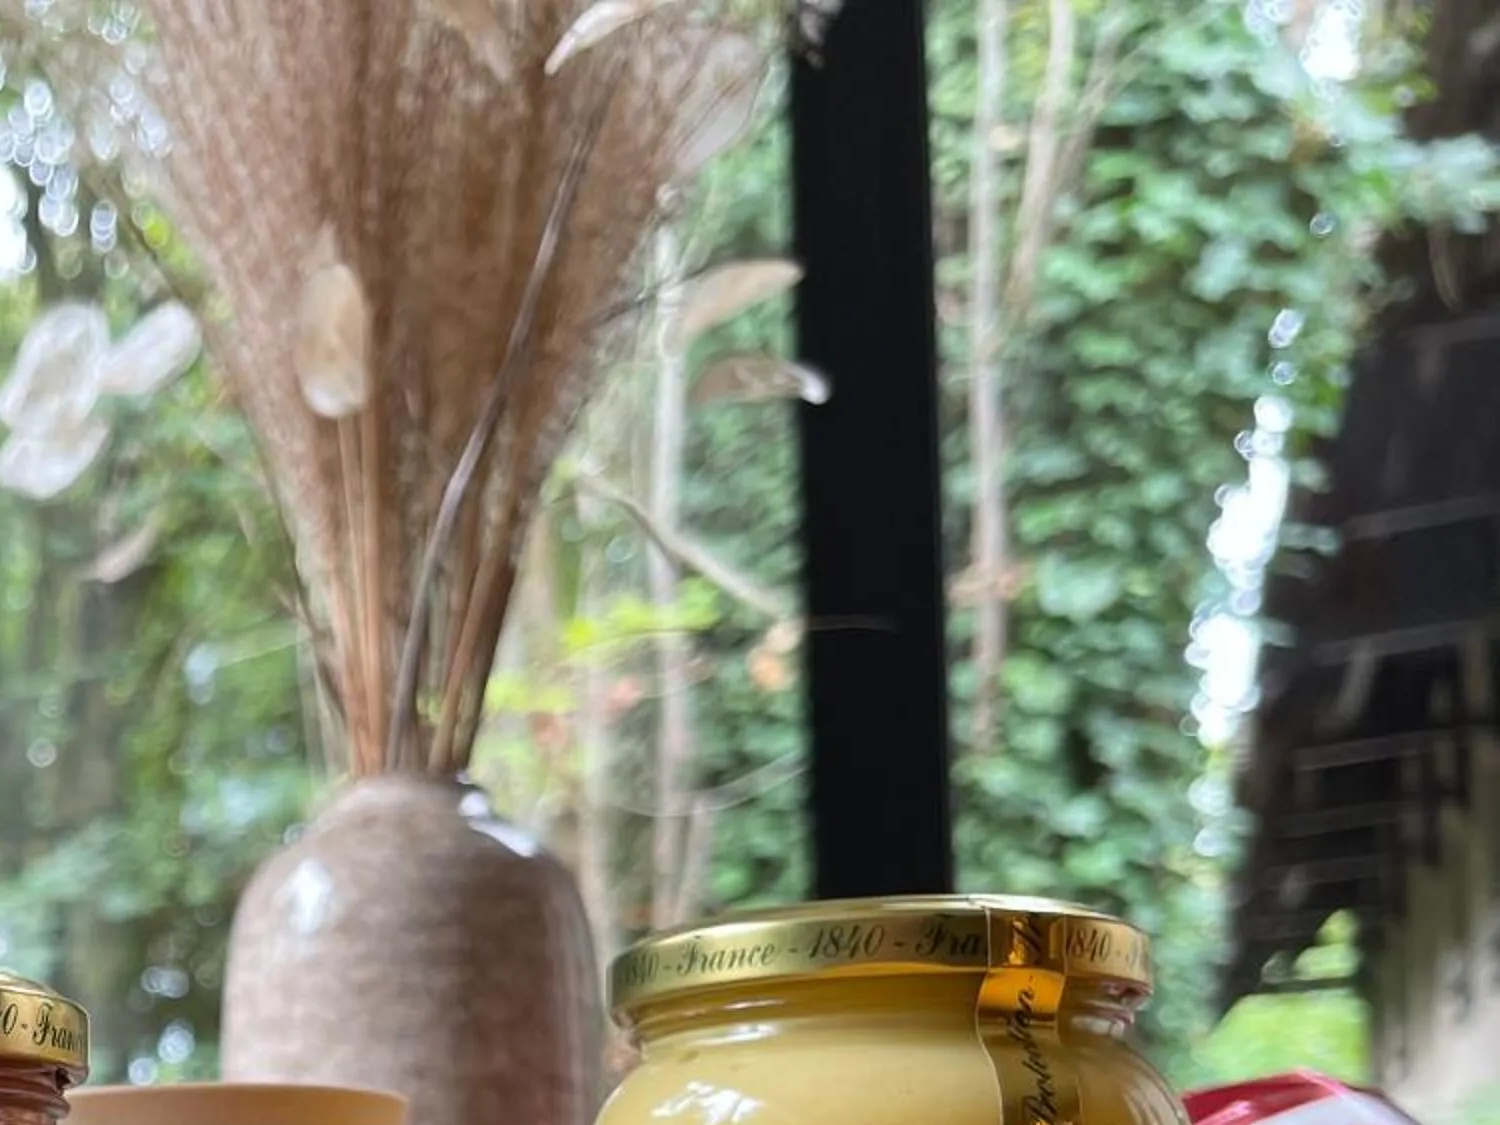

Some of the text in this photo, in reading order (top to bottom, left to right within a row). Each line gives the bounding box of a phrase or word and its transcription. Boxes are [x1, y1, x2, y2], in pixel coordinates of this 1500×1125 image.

[677, 935, 776, 977] France
[809, 925, 885, 960] 1840
[916, 913, 984, 957] Fra
